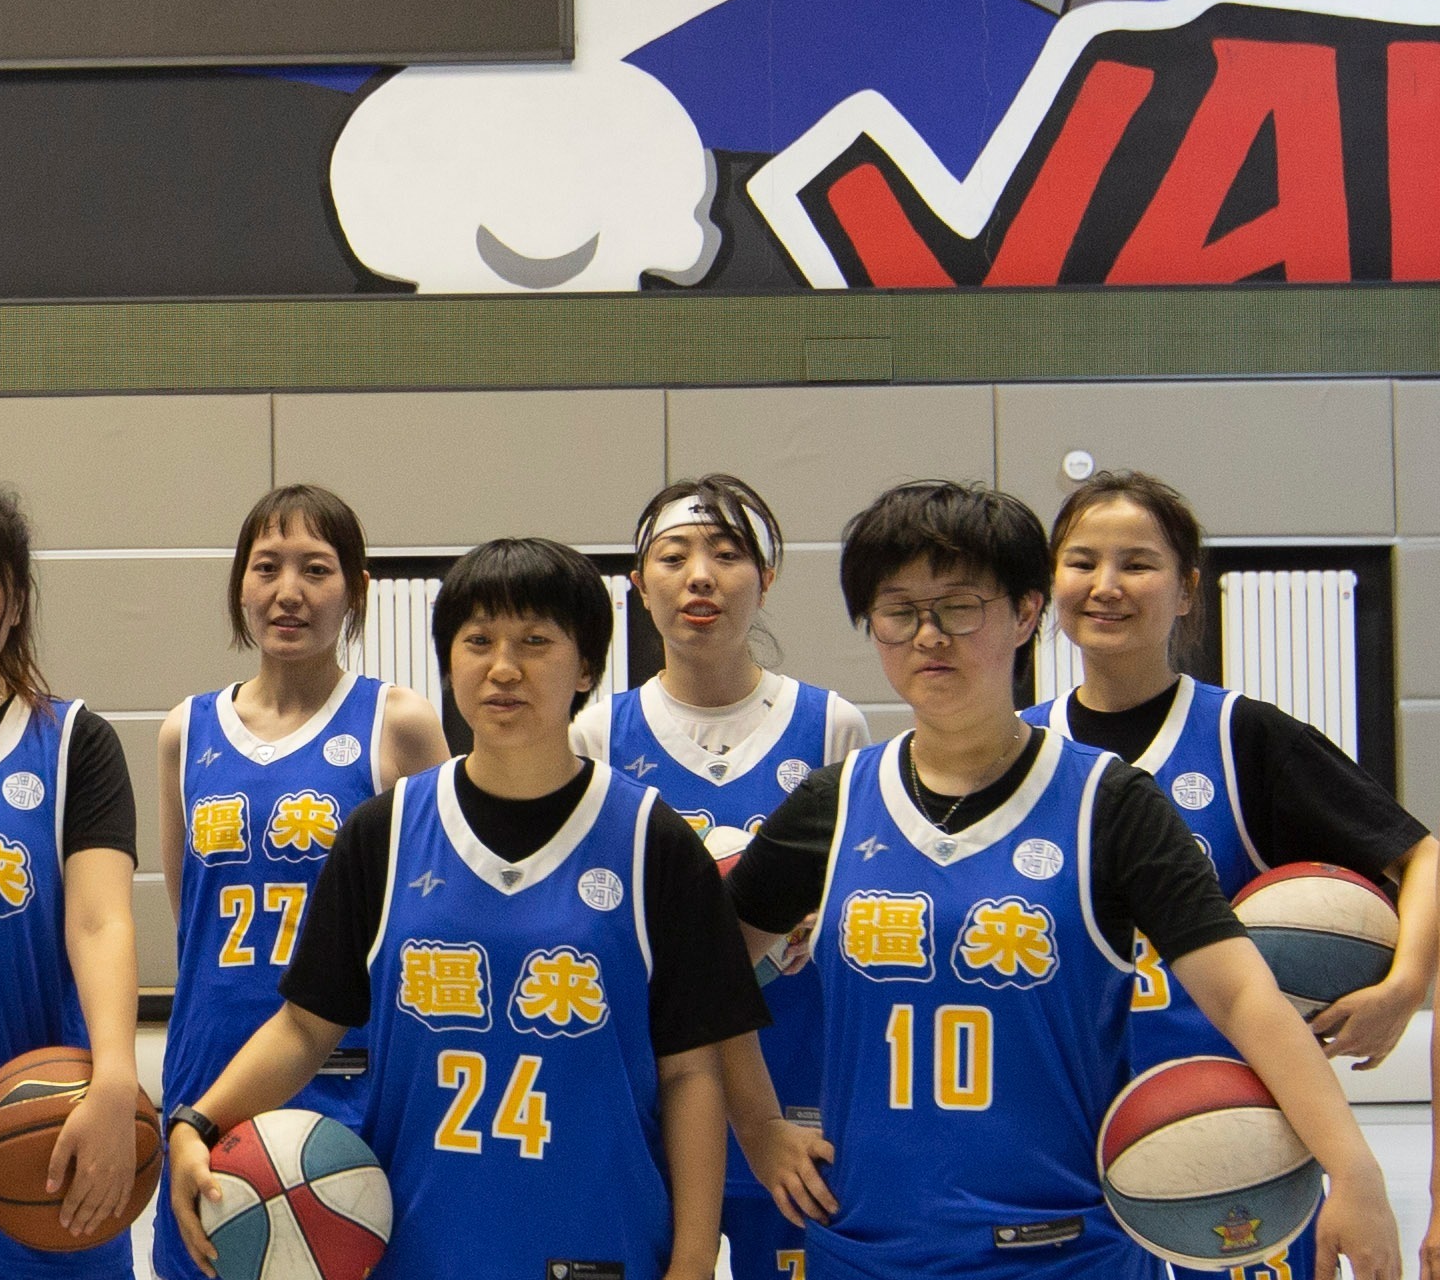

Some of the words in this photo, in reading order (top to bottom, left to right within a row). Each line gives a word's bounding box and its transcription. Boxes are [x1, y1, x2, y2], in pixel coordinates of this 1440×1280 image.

[219, 883, 309, 967] 27
[844, 898, 1053, 978] 疆来
[401, 948, 604, 1026] 疆来
[887, 1005, 993, 1110] 10
[434, 1051, 552, 1159] 24
